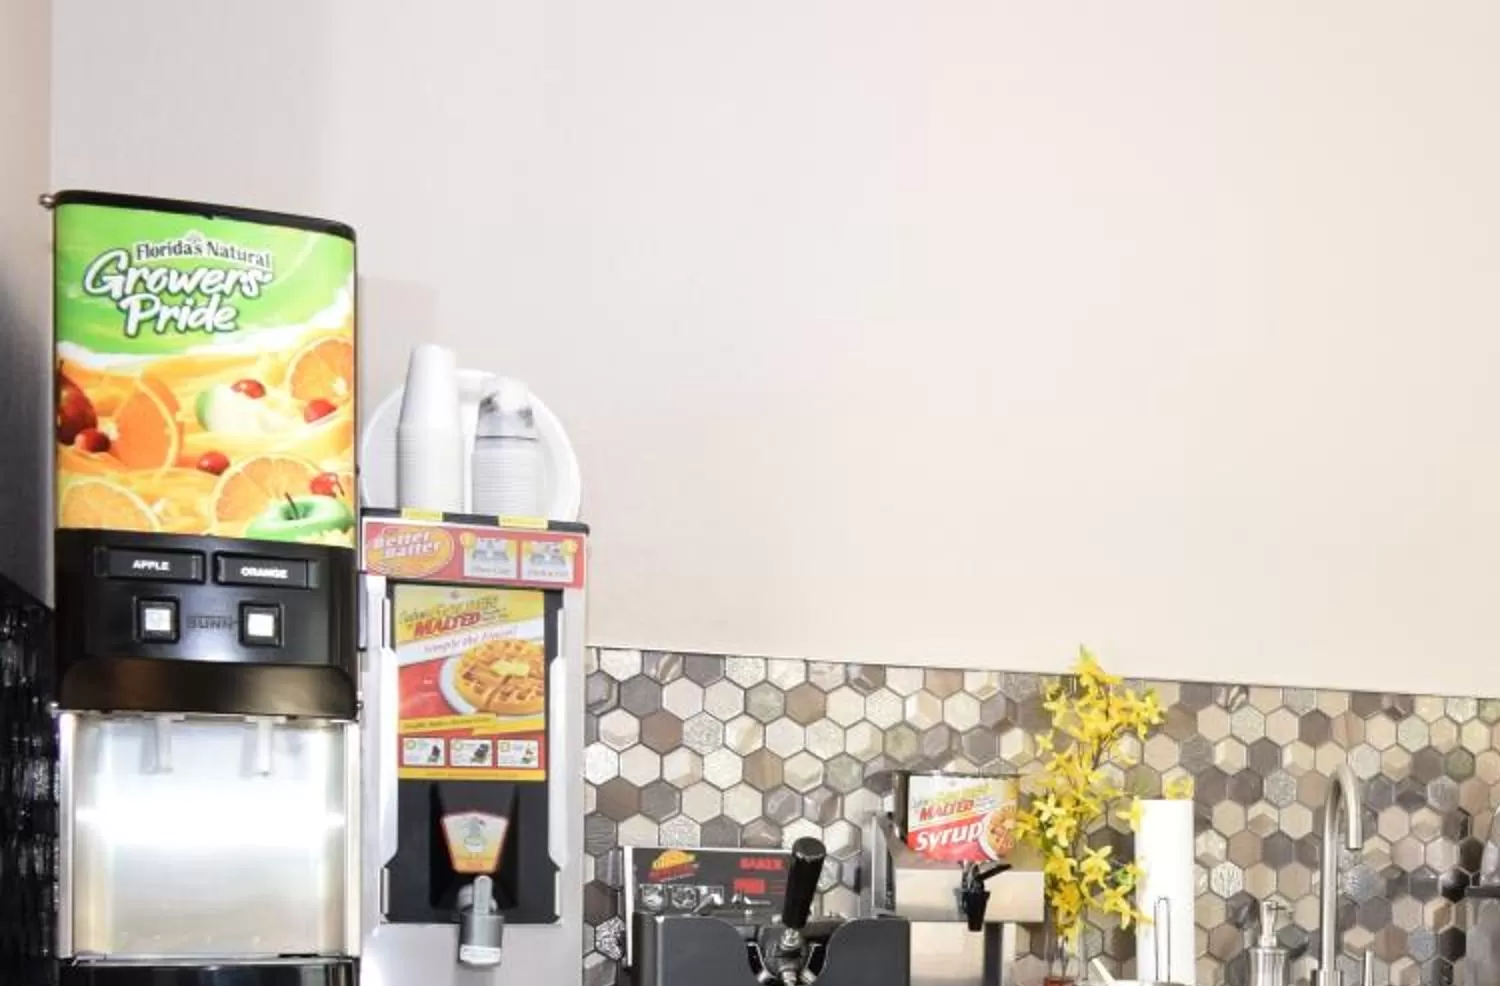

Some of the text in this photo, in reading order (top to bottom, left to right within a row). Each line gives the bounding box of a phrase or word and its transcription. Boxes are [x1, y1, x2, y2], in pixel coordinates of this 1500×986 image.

[207, 240, 271, 269] Natural
[118, 293, 239, 338] Pride
[132, 559, 170, 571] APPLE
[240, 566, 288, 579] ORANGE
[415, 611, 481, 637] MALTED
[915, 822, 984, 852] Syrup
